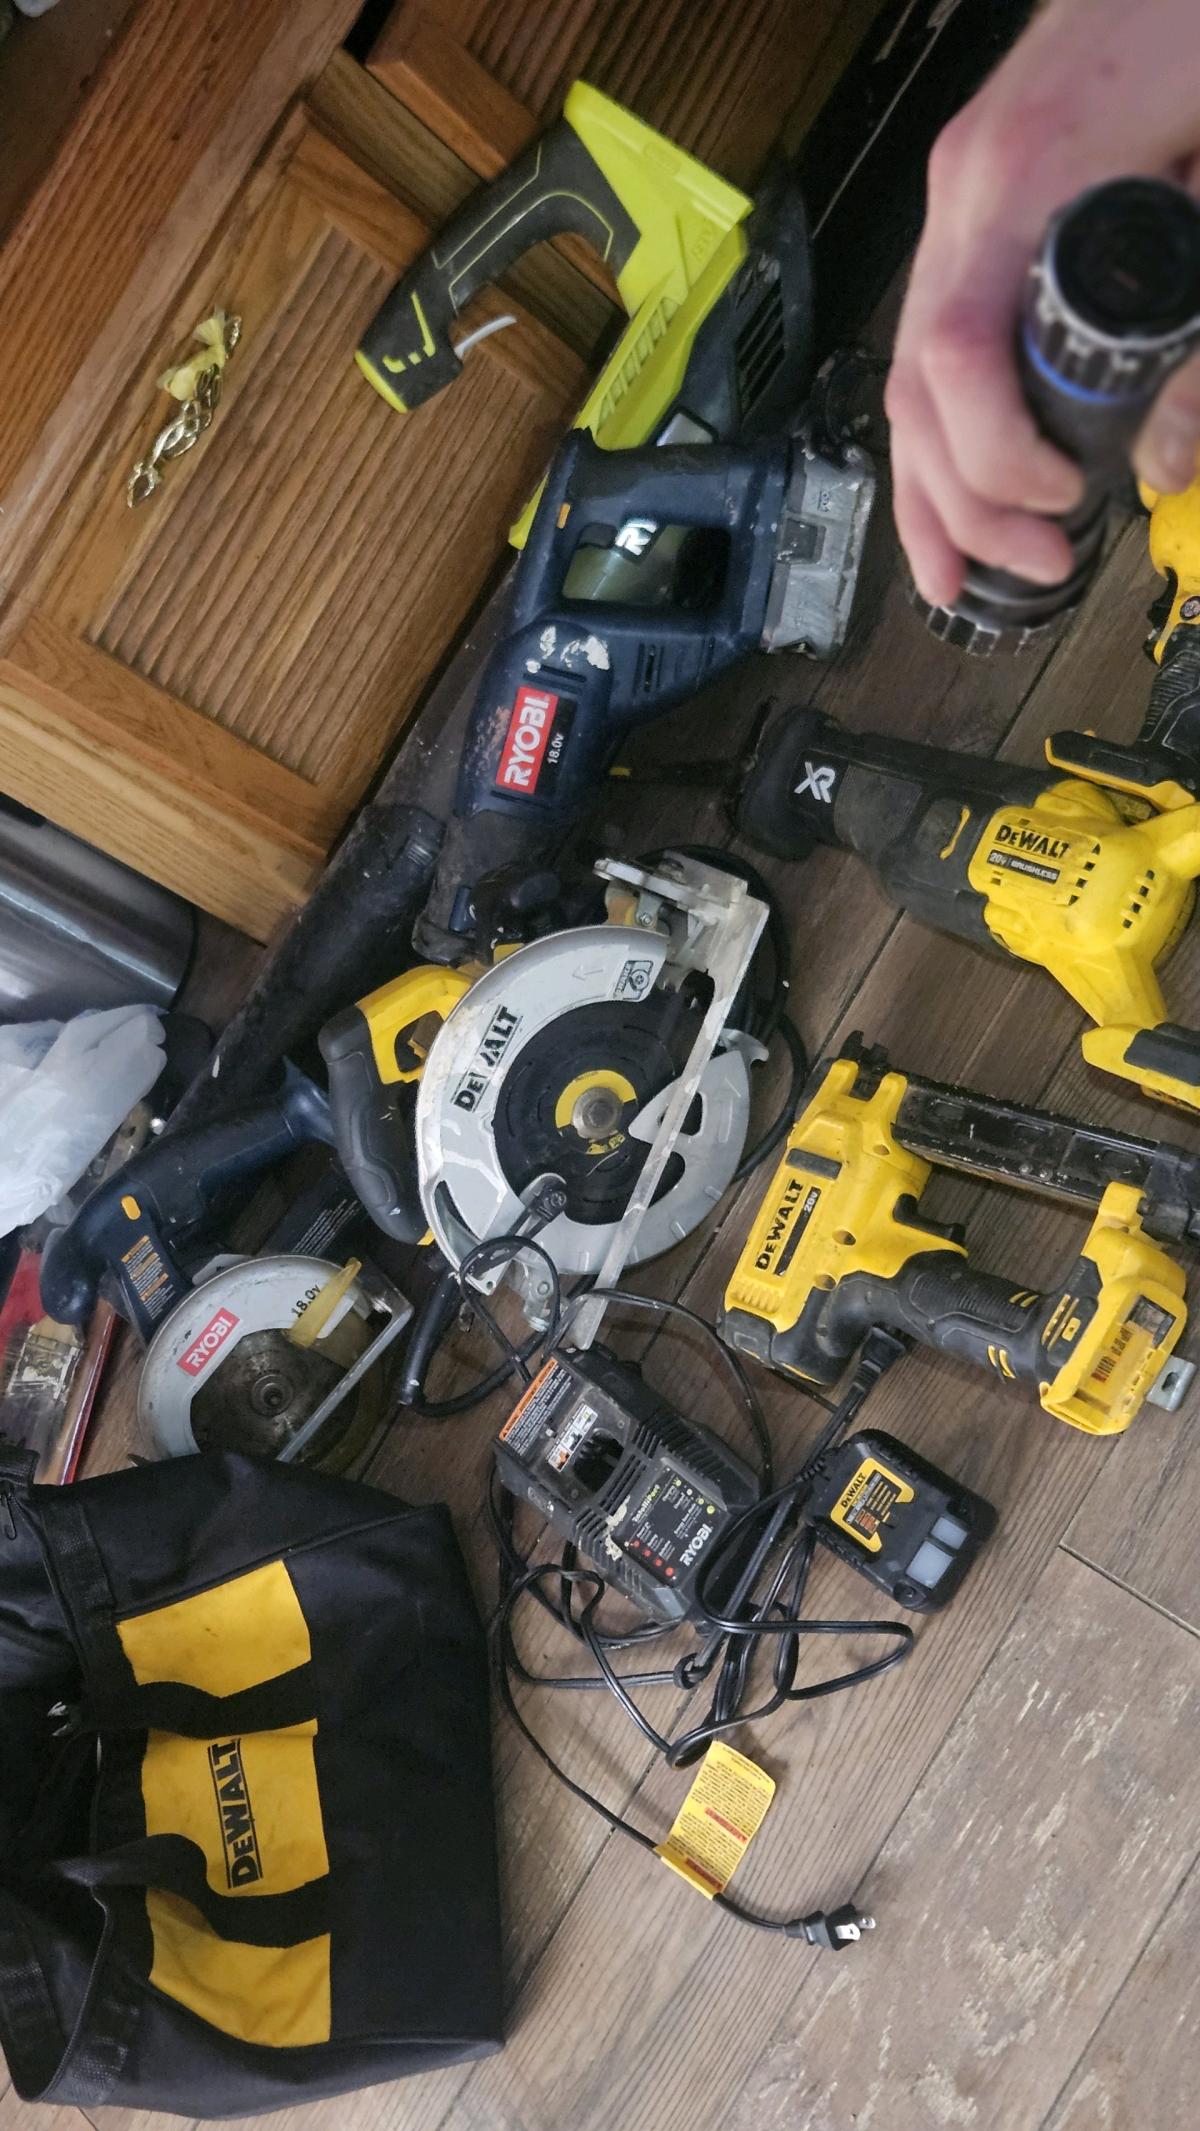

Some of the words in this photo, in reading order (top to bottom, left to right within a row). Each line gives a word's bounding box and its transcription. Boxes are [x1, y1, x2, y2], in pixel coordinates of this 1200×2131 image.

[504, 696, 549, 786] RYOBI
[794, 761, 836, 804] XR
[755, 1179, 803, 1270] DEWALT
[186, 1316, 233, 1368] RYOBI
[680, 1523, 713, 1566] RYOBI
[211, 1741, 261, 1888] DEWALT
